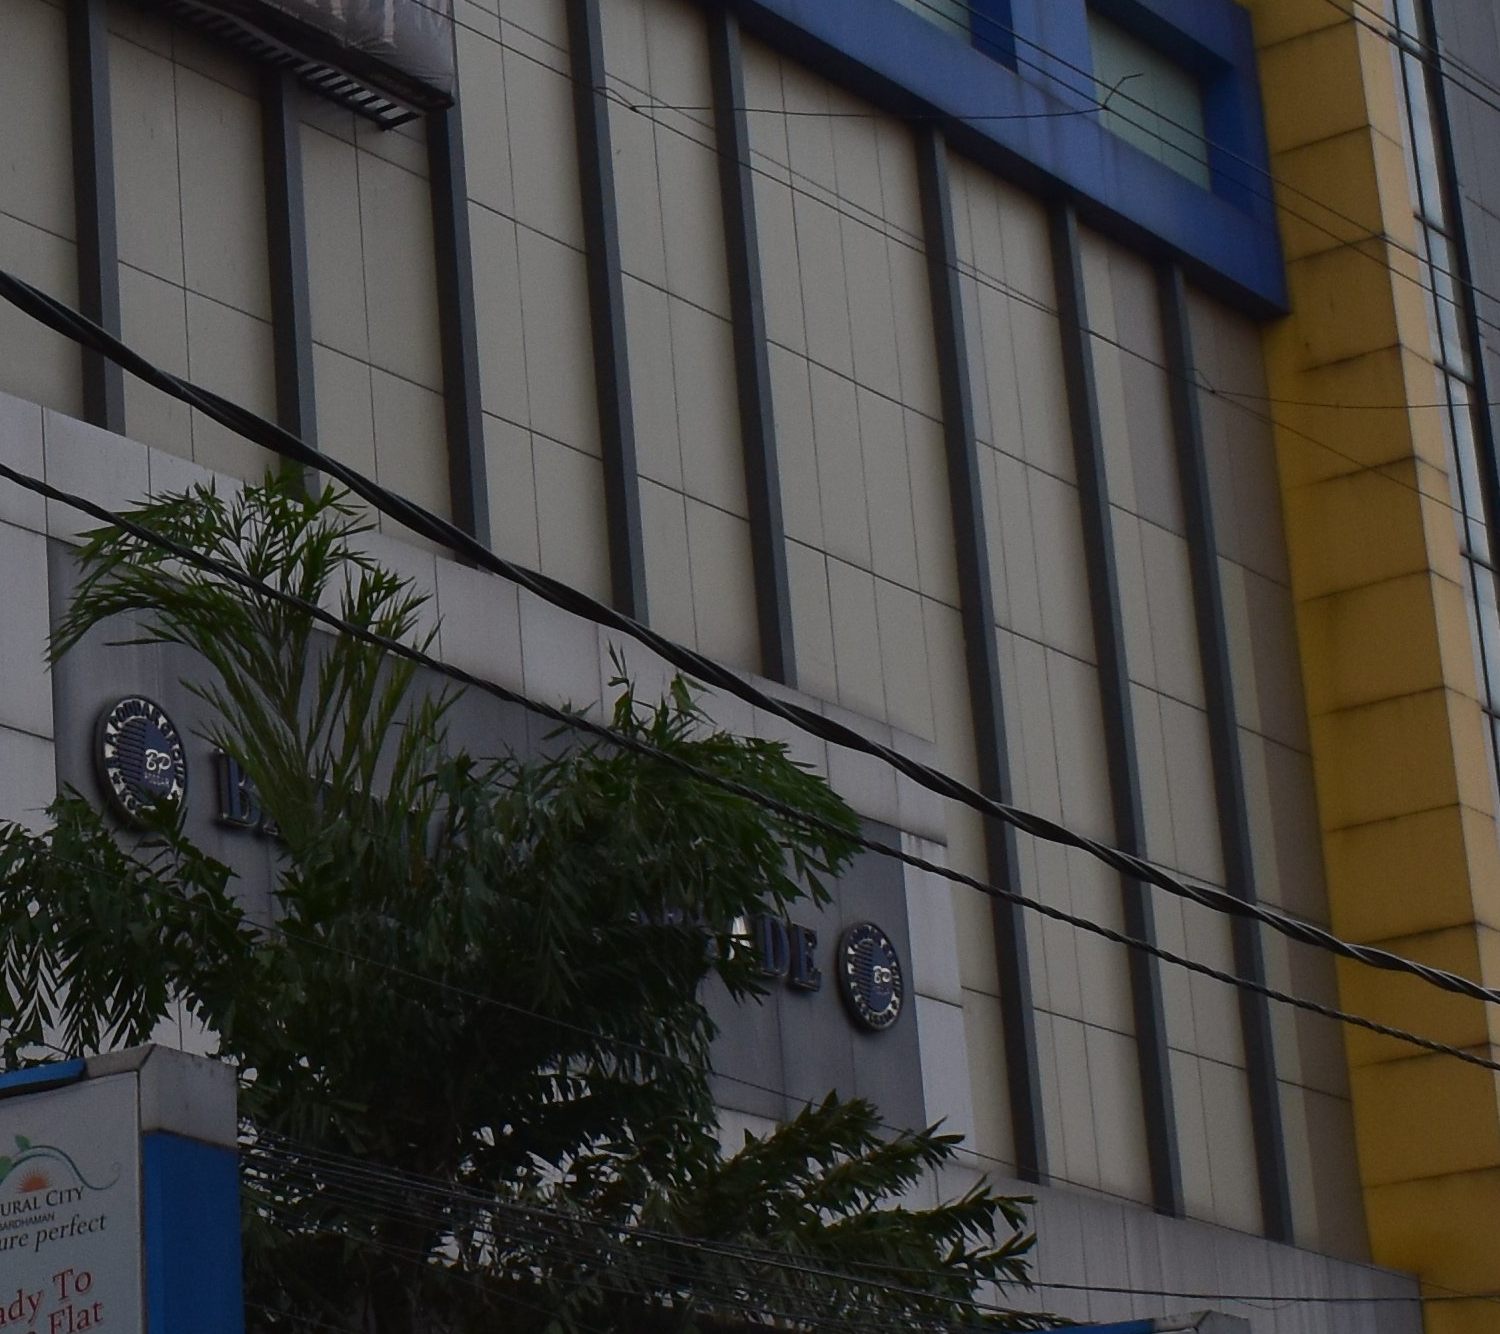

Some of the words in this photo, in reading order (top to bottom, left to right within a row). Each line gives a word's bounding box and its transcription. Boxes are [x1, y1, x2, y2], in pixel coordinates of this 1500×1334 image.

[46, 1186, 84, 1206] CITY
[34, 1214, 107, 1253] perfect
[53, 1269, 92, 1300] To
